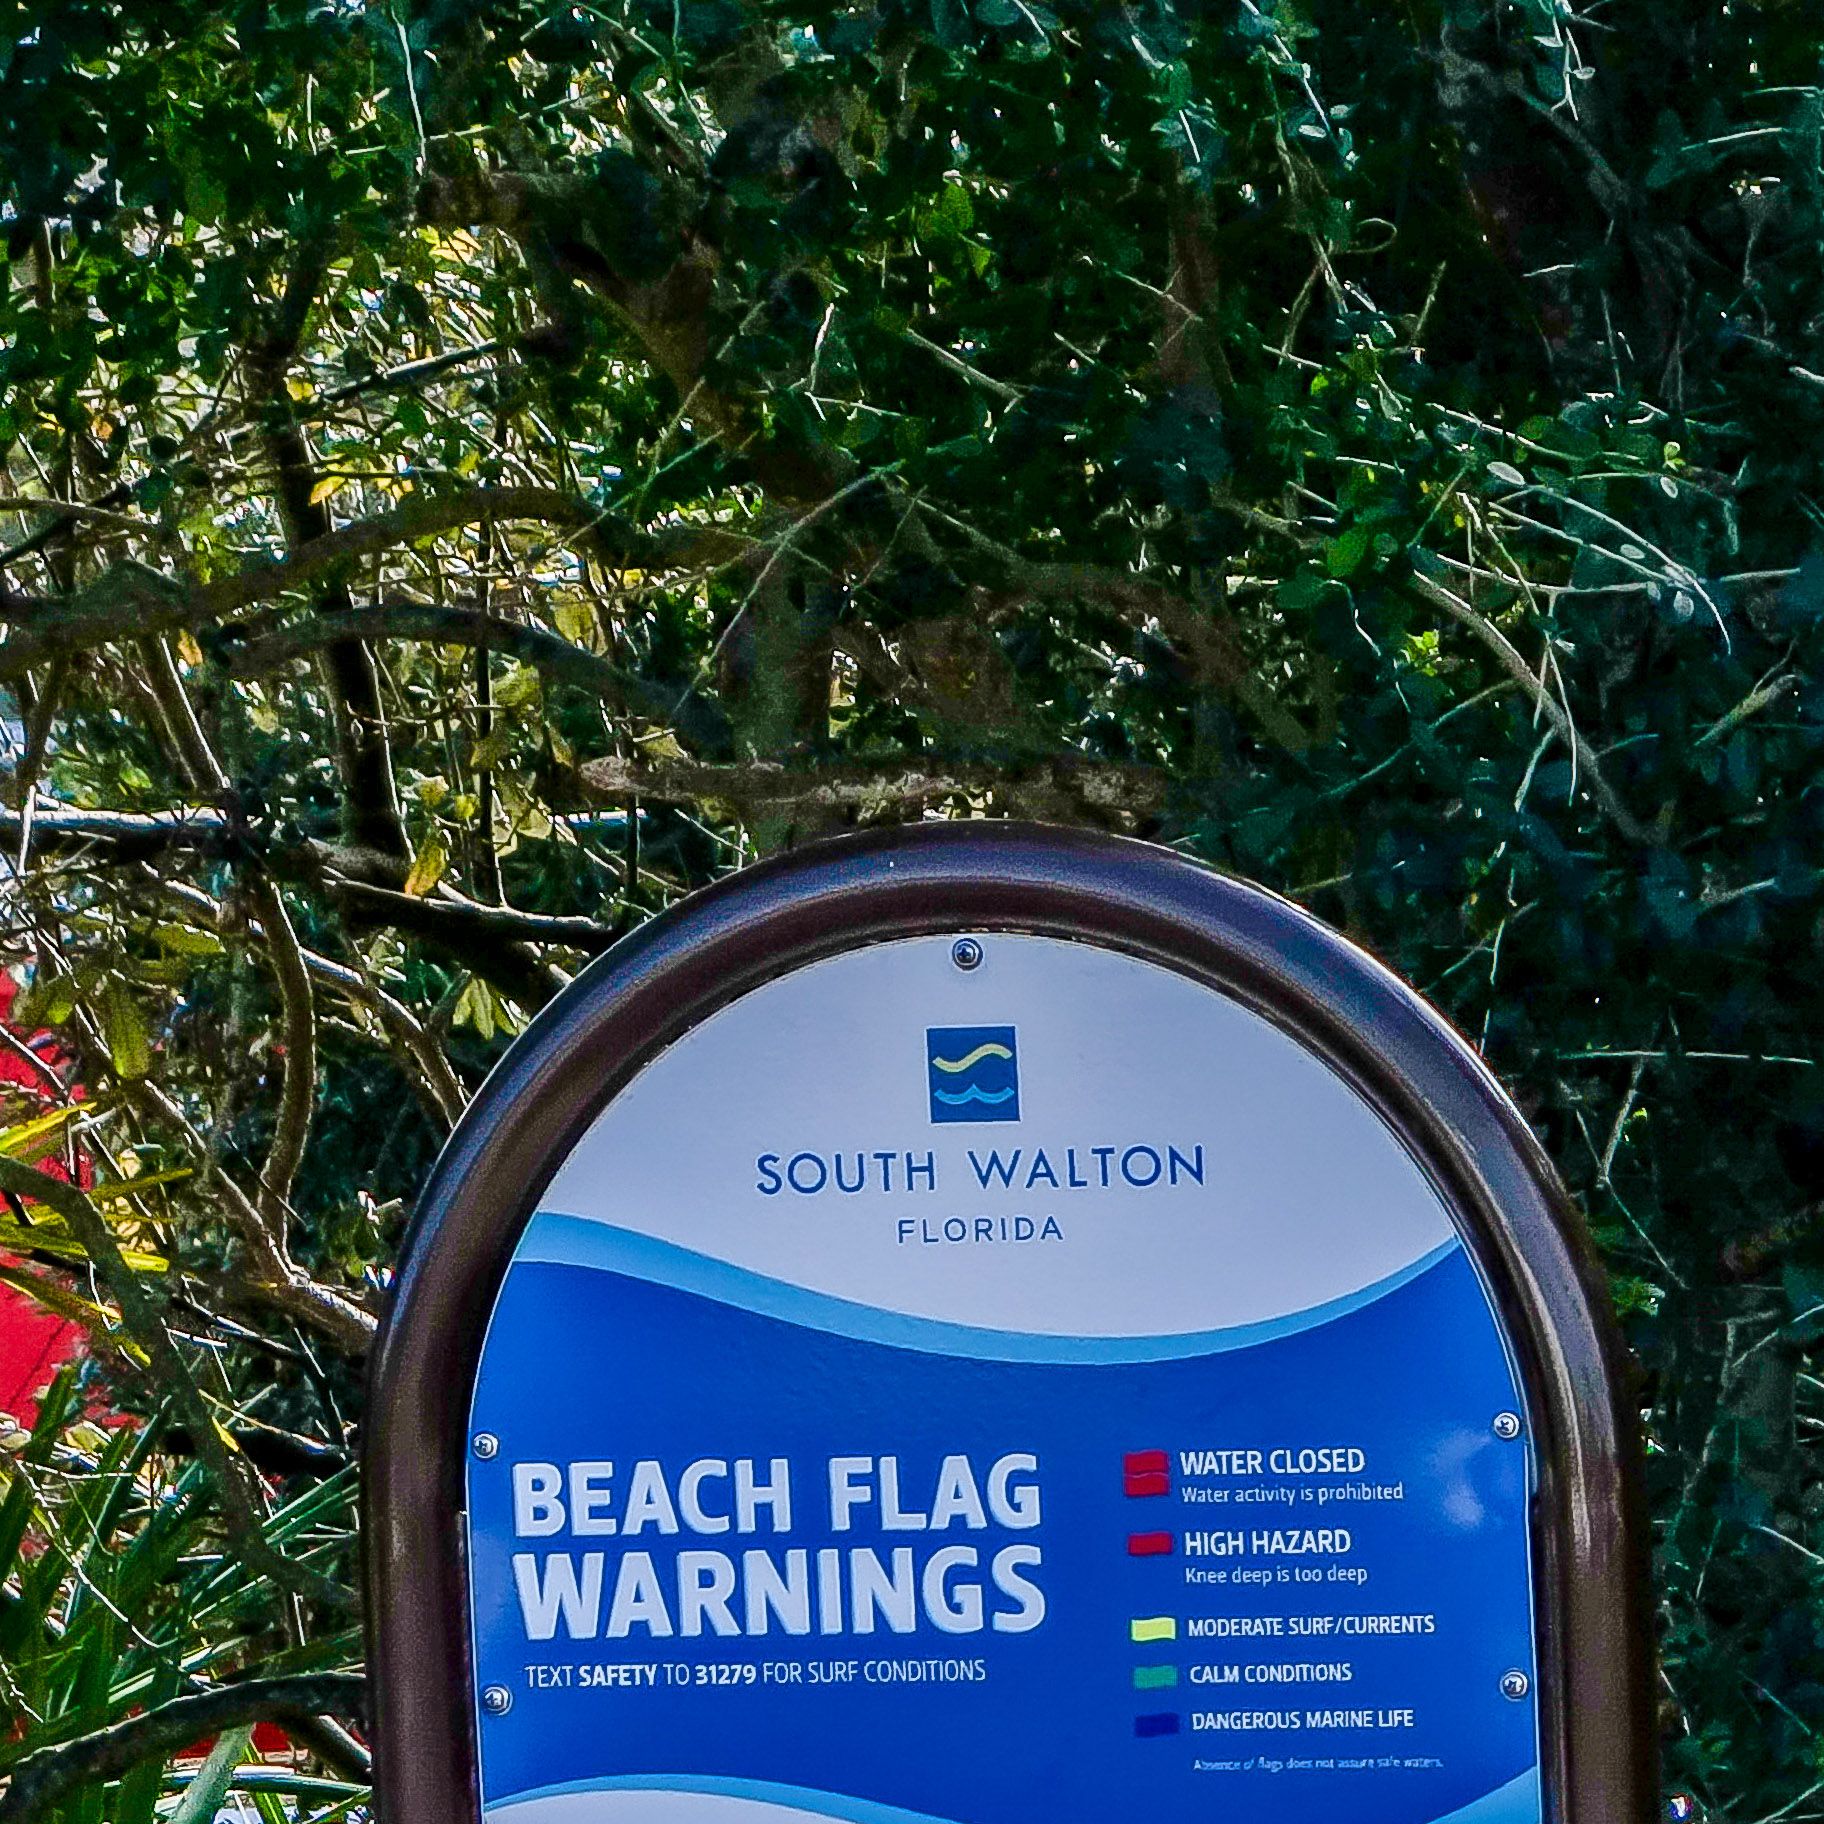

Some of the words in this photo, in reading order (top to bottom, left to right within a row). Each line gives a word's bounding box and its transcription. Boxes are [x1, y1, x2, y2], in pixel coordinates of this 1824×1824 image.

[757, 1151, 934, 1195] SOUTH
[968, 1145, 1203, 1189] WALTON
[898, 1216, 1063, 1244] FLORIDA
[1180, 1450, 1263, 1475] WATER
[1270, 1448, 1365, 1474] CLOSED
[513, 1458, 791, 1537] BEACH
[829, 1453, 1040, 1531] FLAG
[1182, 1486, 1229, 1503] Water
[1235, 1484, 1295, 1506] activity
[1301, 1488, 1313, 1501] is
[1318, 1482, 1403, 1505] prohibited
[1185, 1531, 1244, 1556] HIGH
[1252, 1529, 1350, 1554] HAZARD
[1186, 1567, 1226, 1584] Knee
[1232, 1566, 1272, 1587] deep
[1277, 1565, 1289, 1582] is
[1295, 1567, 1322, 1582] too
[1327, 1564, 1367, 1586] deep
[512, 1545, 1045, 1640] WARNINGS
[1189, 1617, 1283, 1637] MODERATE
[1289, 1615, 1434, 1635] SURF/CURRENTS
[525, 1665, 573, 1687] TEXT
[579, 1664, 657, 1686] SAFETY
[663, 1663, 689, 1685] TO
[695, 1664, 756, 1685] 31279
[763, 1662, 802, 1684] FOR
[808, 1661, 858, 1684] SURF
[864, 1659, 985, 1683] CONDITIONS
[1190, 1665, 1239, 1683] CALM
[1245, 1663, 1352, 1683] CONDITIONS
[1192, 1711, 1300, 1730] DANGEROUS
[1307, 1710, 1373, 1728] MARINE
[1378, 1710, 1413, 1728] LIFE
